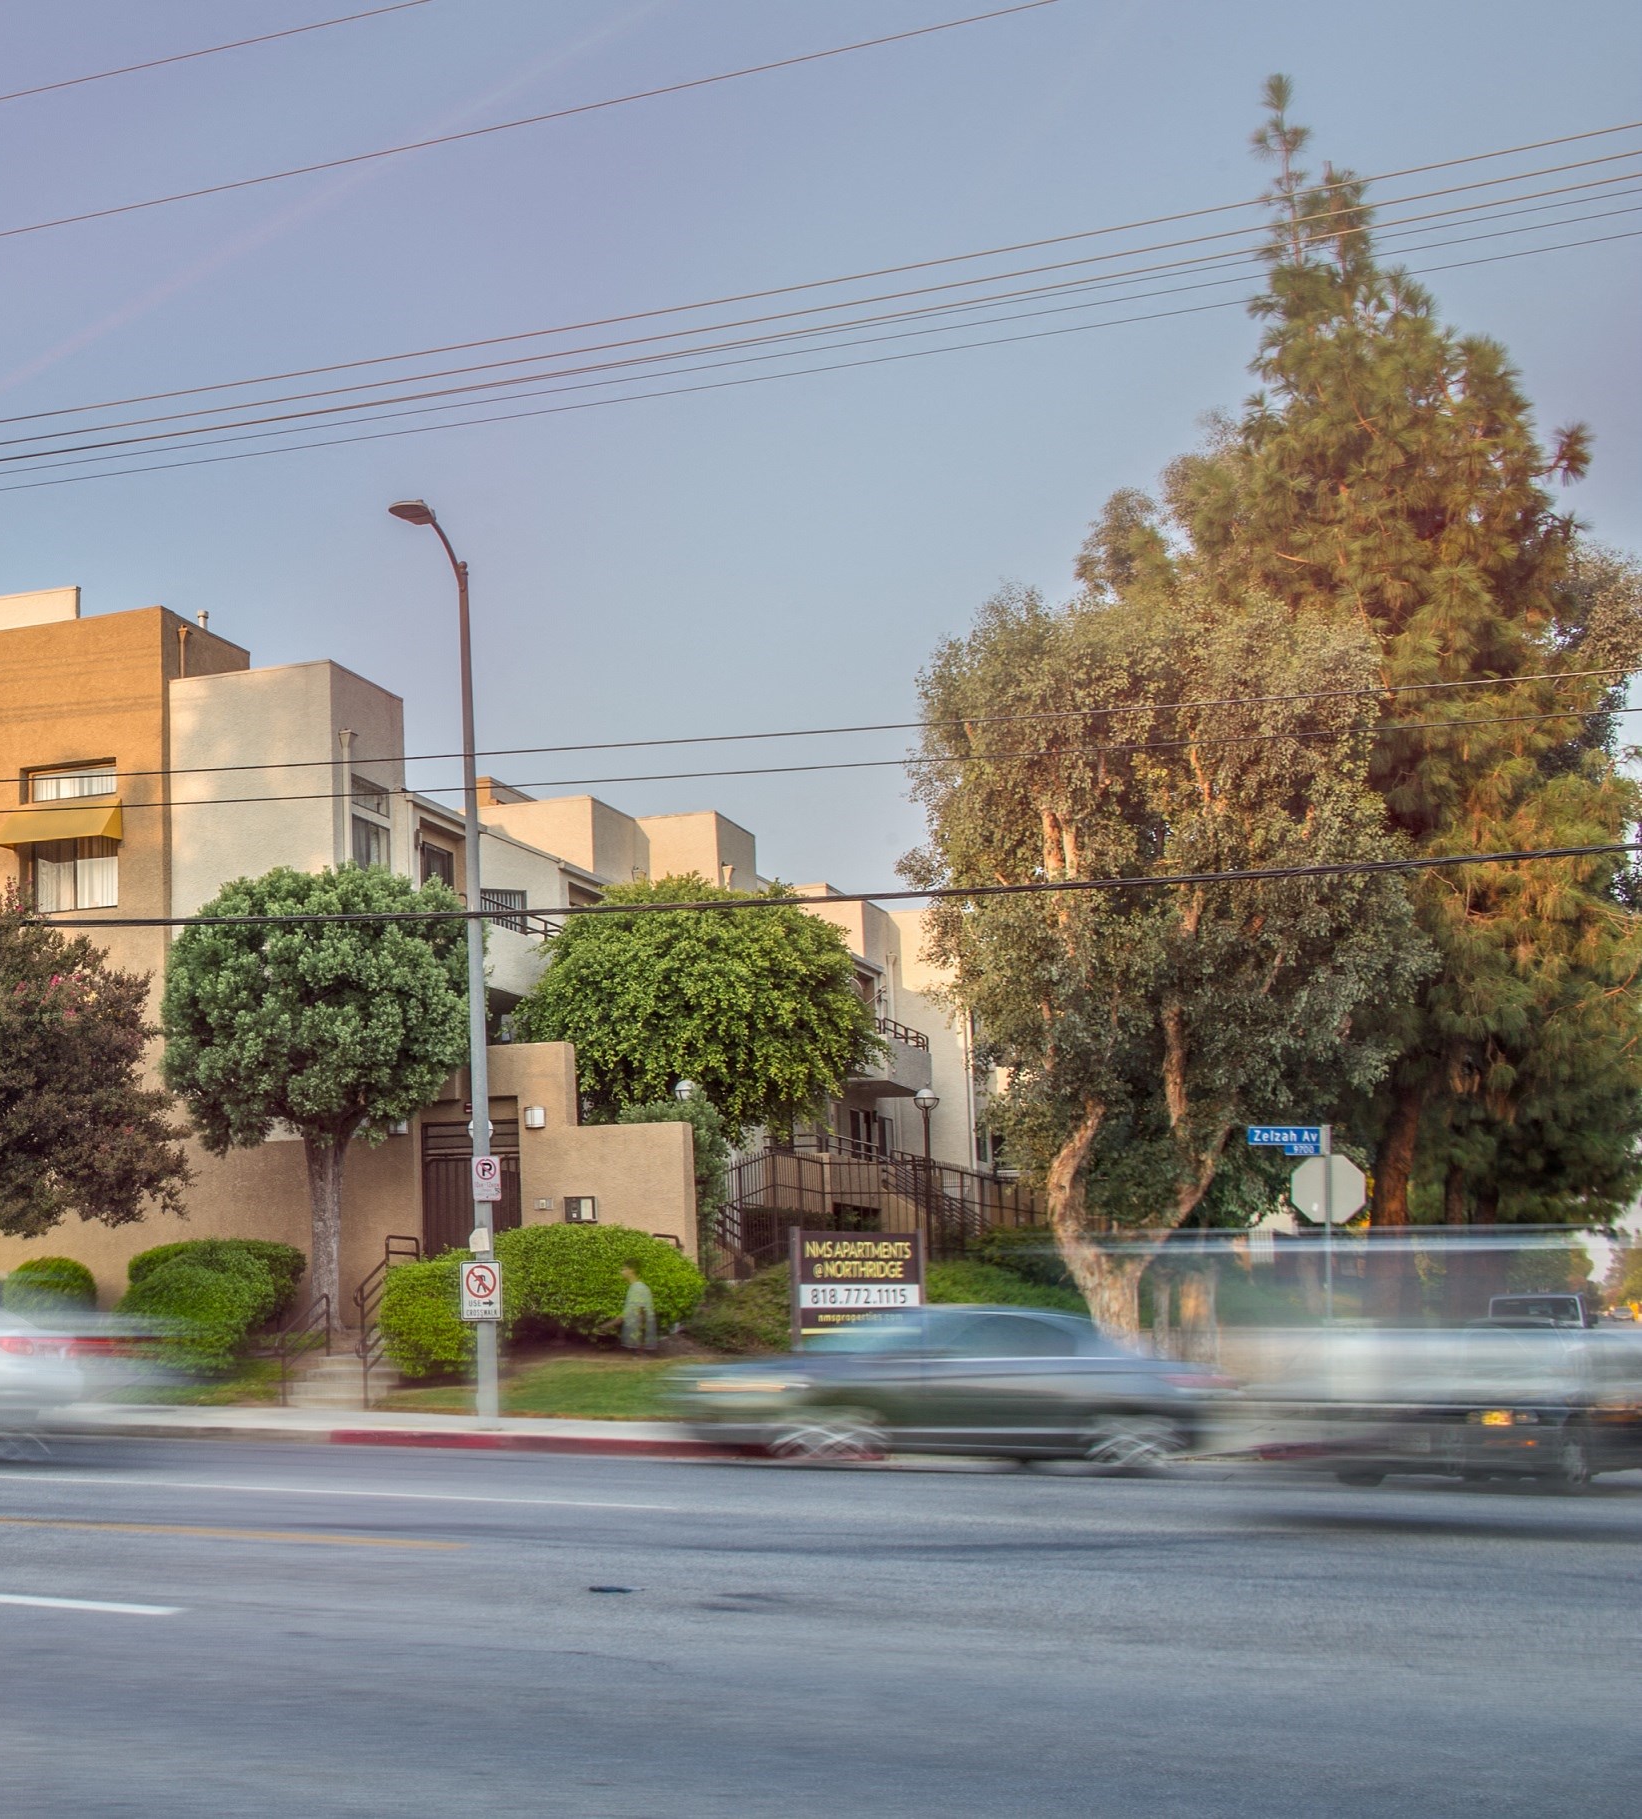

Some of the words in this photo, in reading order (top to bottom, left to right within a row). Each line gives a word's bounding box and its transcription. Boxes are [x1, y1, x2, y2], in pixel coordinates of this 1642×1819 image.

[1253, 1130, 1297, 1142] Zelzah
[1302, 1130, 1318, 1142] Av
[1292, 1145, 1315, 1154] 9700
[804, 1241, 833, 1258] NMS
[834, 1241, 912, 1259] APARTMENTS
[810, 1288, 907, 1305] 818.772.1115
[466, 1309, 498, 1317] CROSSWALK
[817, 1312, 904, 1325] nmsproperties.com
